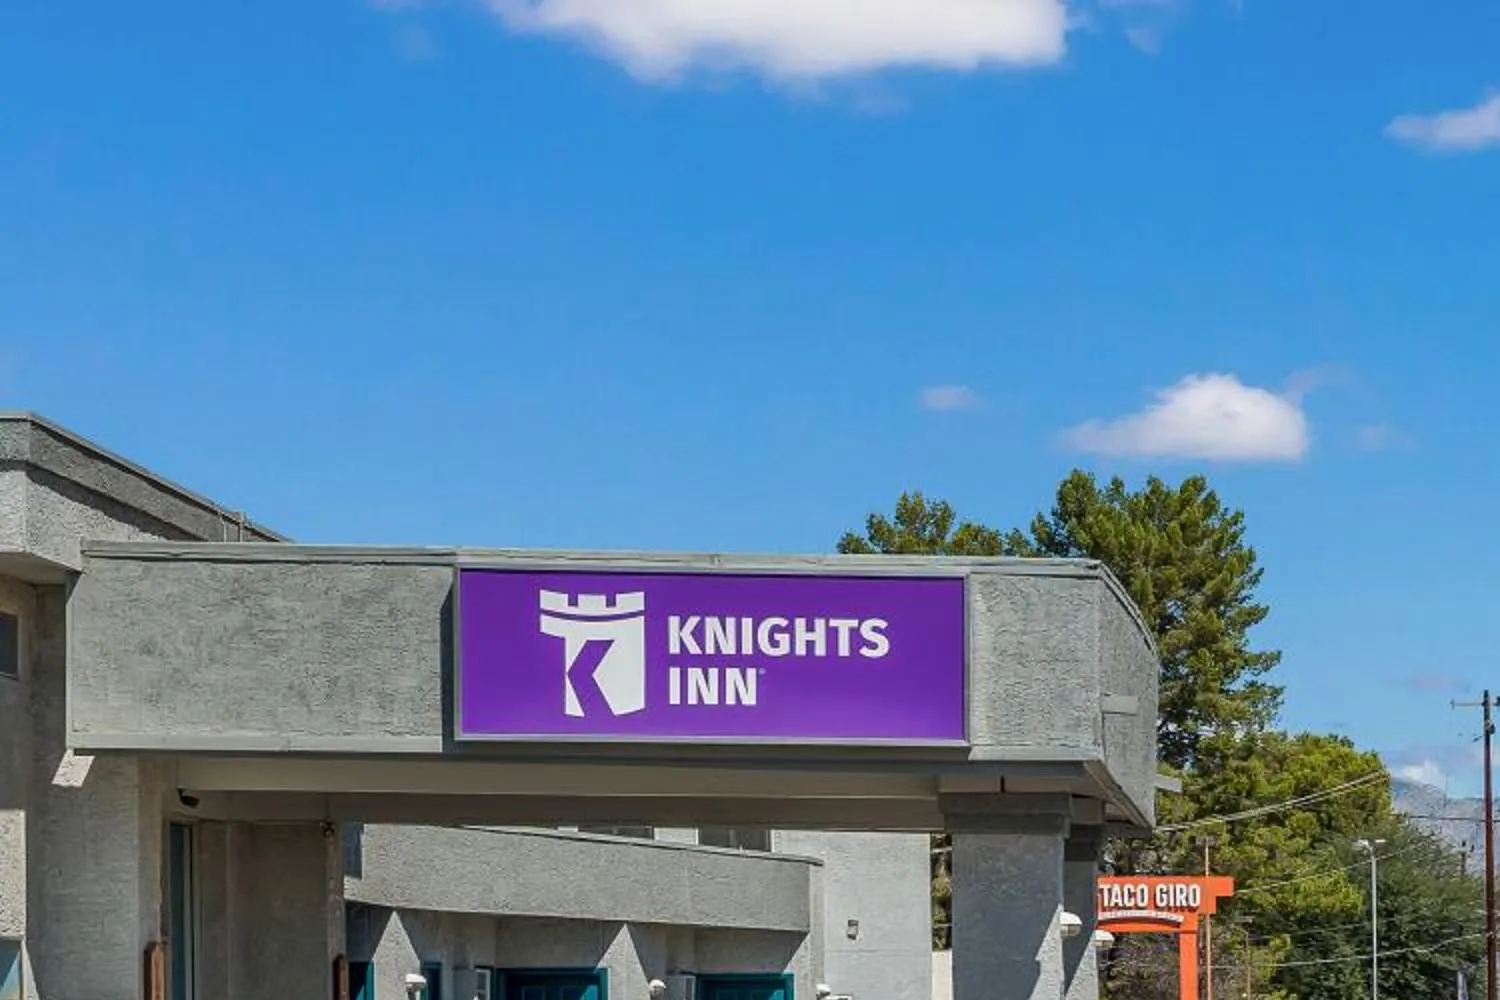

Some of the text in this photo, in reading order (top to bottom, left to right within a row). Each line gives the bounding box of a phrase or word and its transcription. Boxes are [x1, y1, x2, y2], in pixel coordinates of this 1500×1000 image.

[669, 616, 890, 658] KNIGHTS
[669, 667, 758, 706] INN
[1100, 883, 1201, 907] TACO GIRO
